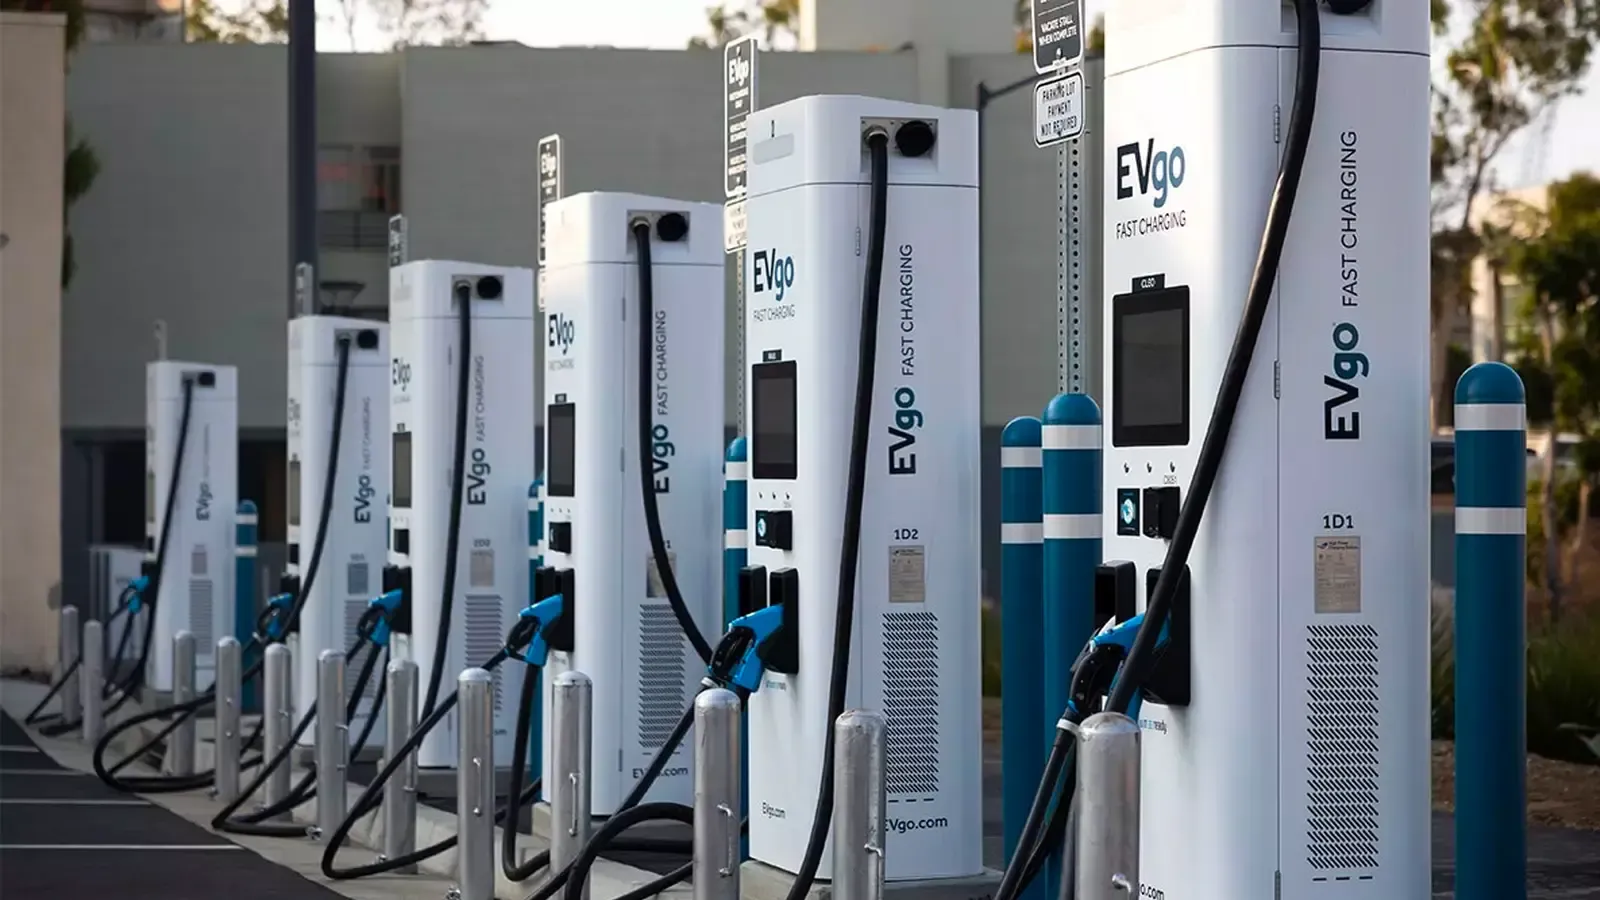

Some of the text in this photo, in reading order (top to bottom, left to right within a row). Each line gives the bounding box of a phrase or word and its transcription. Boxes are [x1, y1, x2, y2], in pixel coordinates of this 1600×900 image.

[1038, 25, 1077, 46] WHEN COMPLETE
[1040, 15, 1073, 33] VACATE STALL
[729, 57, 749, 87] EVgo
[1043, 81, 1075, 102] PARKING LOT
[1048, 100, 1071, 118] PAYMENT
[1041, 122, 1051, 136] NOT
[1117, 138, 1186, 208] EVgo
[1116, 209, 1186, 239] FAST CHARGING
[754, 248, 794, 301] EVgo
[1324, 131, 1369, 440] EVgo FAST CHARGING
[549, 312, 574, 355] EVgo
[888, 244, 923, 475] EVgo FAST CHARGING
[474, 355, 485, 413] CHARGING
[652, 310, 675, 493] EVgo FAST CHARGING
[467, 448, 491, 505] EVgo
[354, 475, 375, 524] EVgo
[894, 528, 918, 540] 1D2
[1323, 514, 1354, 529] 1D1
